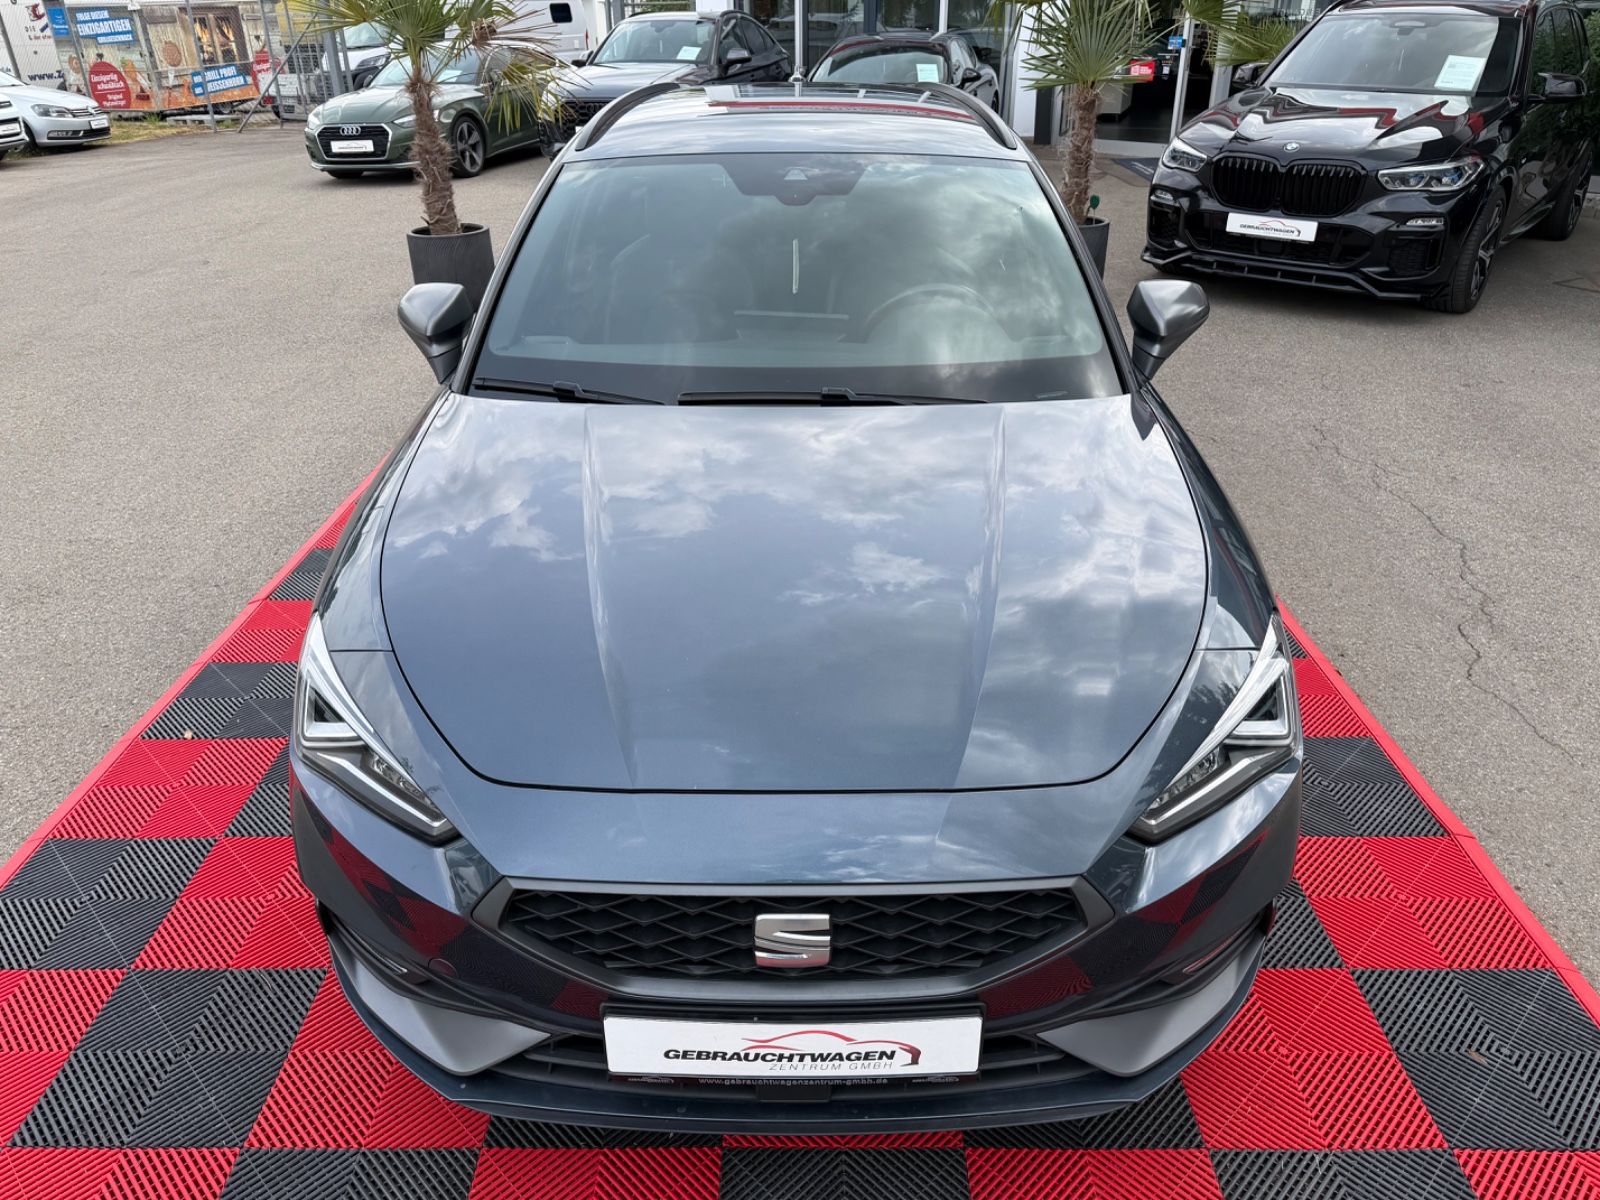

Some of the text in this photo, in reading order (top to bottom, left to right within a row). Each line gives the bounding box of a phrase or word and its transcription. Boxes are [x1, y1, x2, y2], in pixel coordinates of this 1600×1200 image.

[76, 18, 132, 36] EINZIGARTIGEN
[663, 1049, 896, 1063] GEBRAUCHTWAGEN
[768, 1061, 894, 1071] ZENTRUM GMBH
[698, 1077, 888, 1085] www.gebrauchtwagenzentrum-gmbh.de
